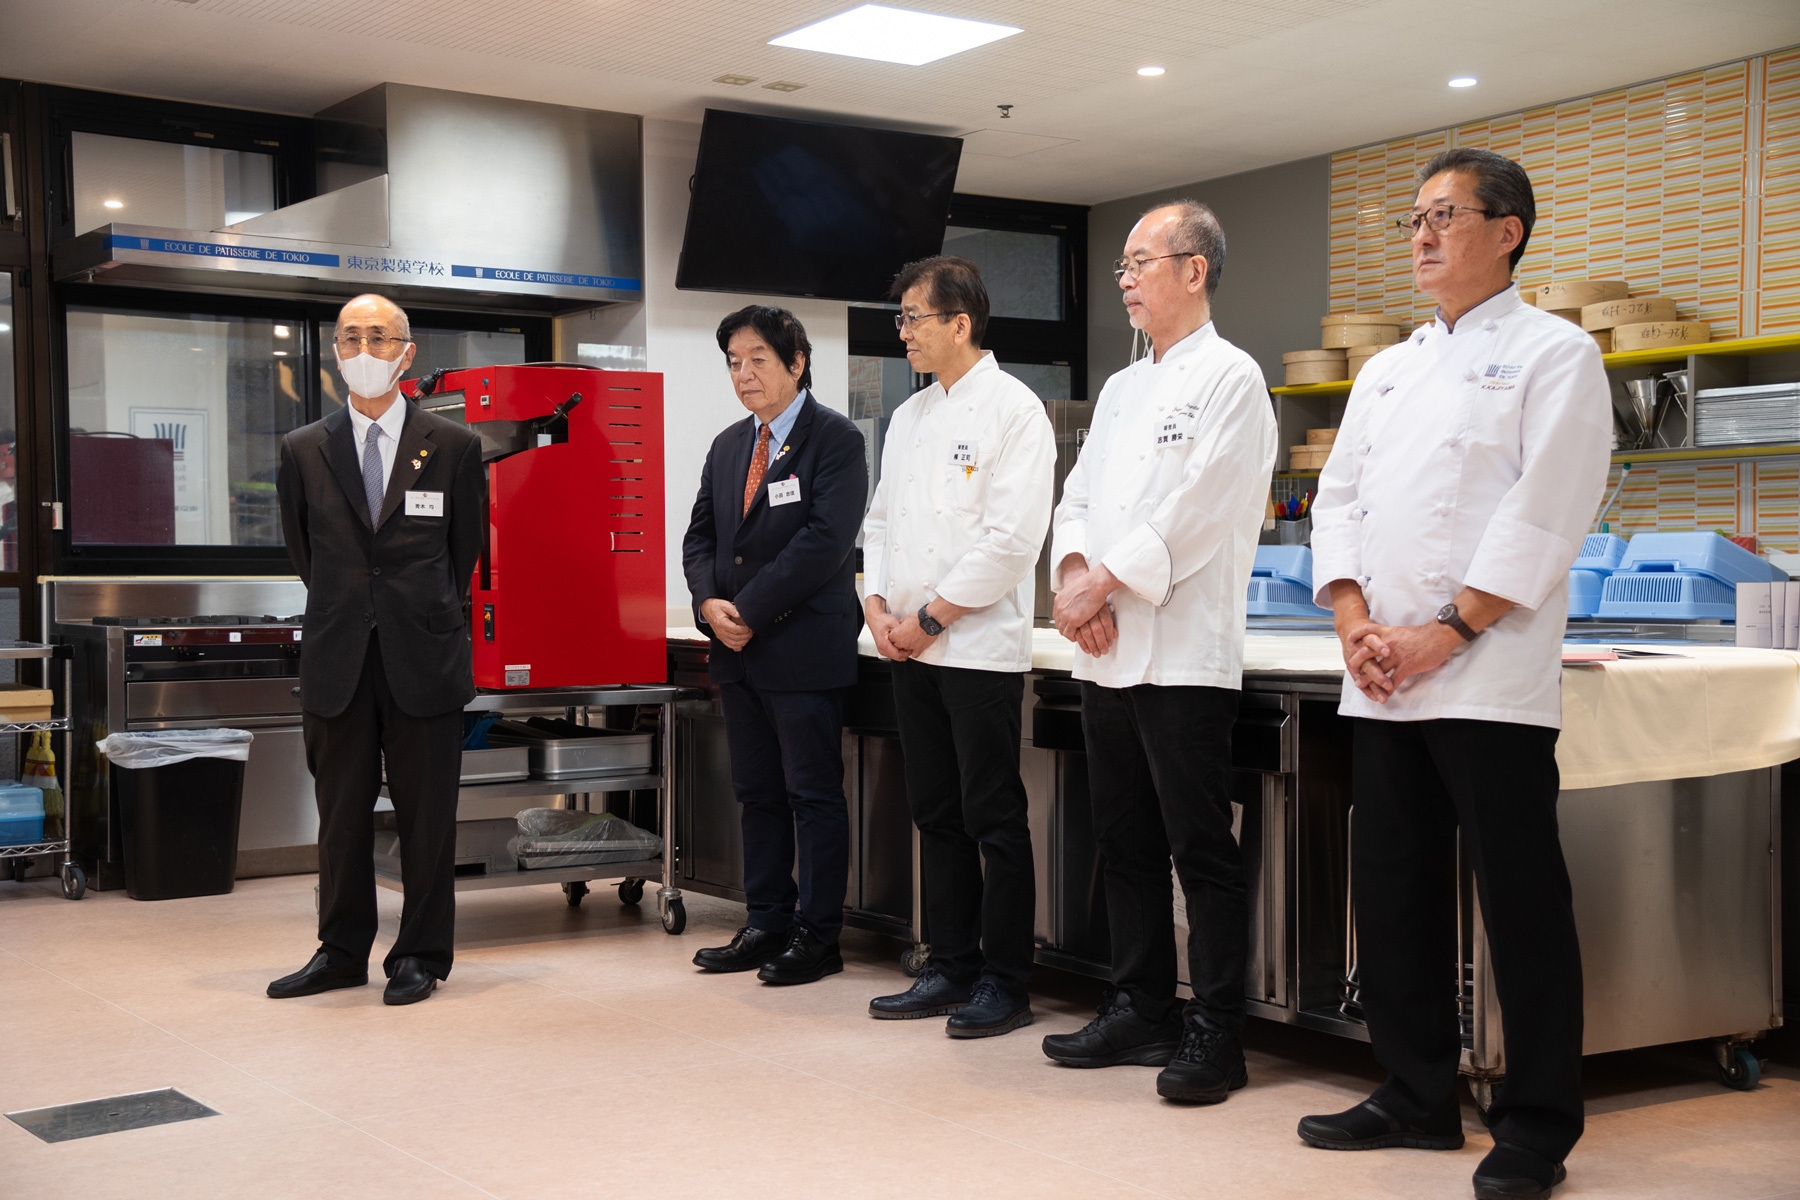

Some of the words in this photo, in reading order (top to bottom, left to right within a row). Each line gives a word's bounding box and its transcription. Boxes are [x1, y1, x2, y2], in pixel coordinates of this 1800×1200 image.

[164, 241, 195, 253] ECOLE
[199, 245, 211, 255] DE
[215, 246, 260, 259] PATISSERIE
[265, 250, 278, 261] DE
[282, 252, 310, 263] TOKIO
[346, 254, 445, 276] 東京製菓学校
[495, 269, 520, 281] ECOLE
[523, 271, 534, 282] DE
[537, 273, 574, 285] PATISSERIE
[578, 276, 589, 286] DE
[592, 277, 616, 288] TOKIO
